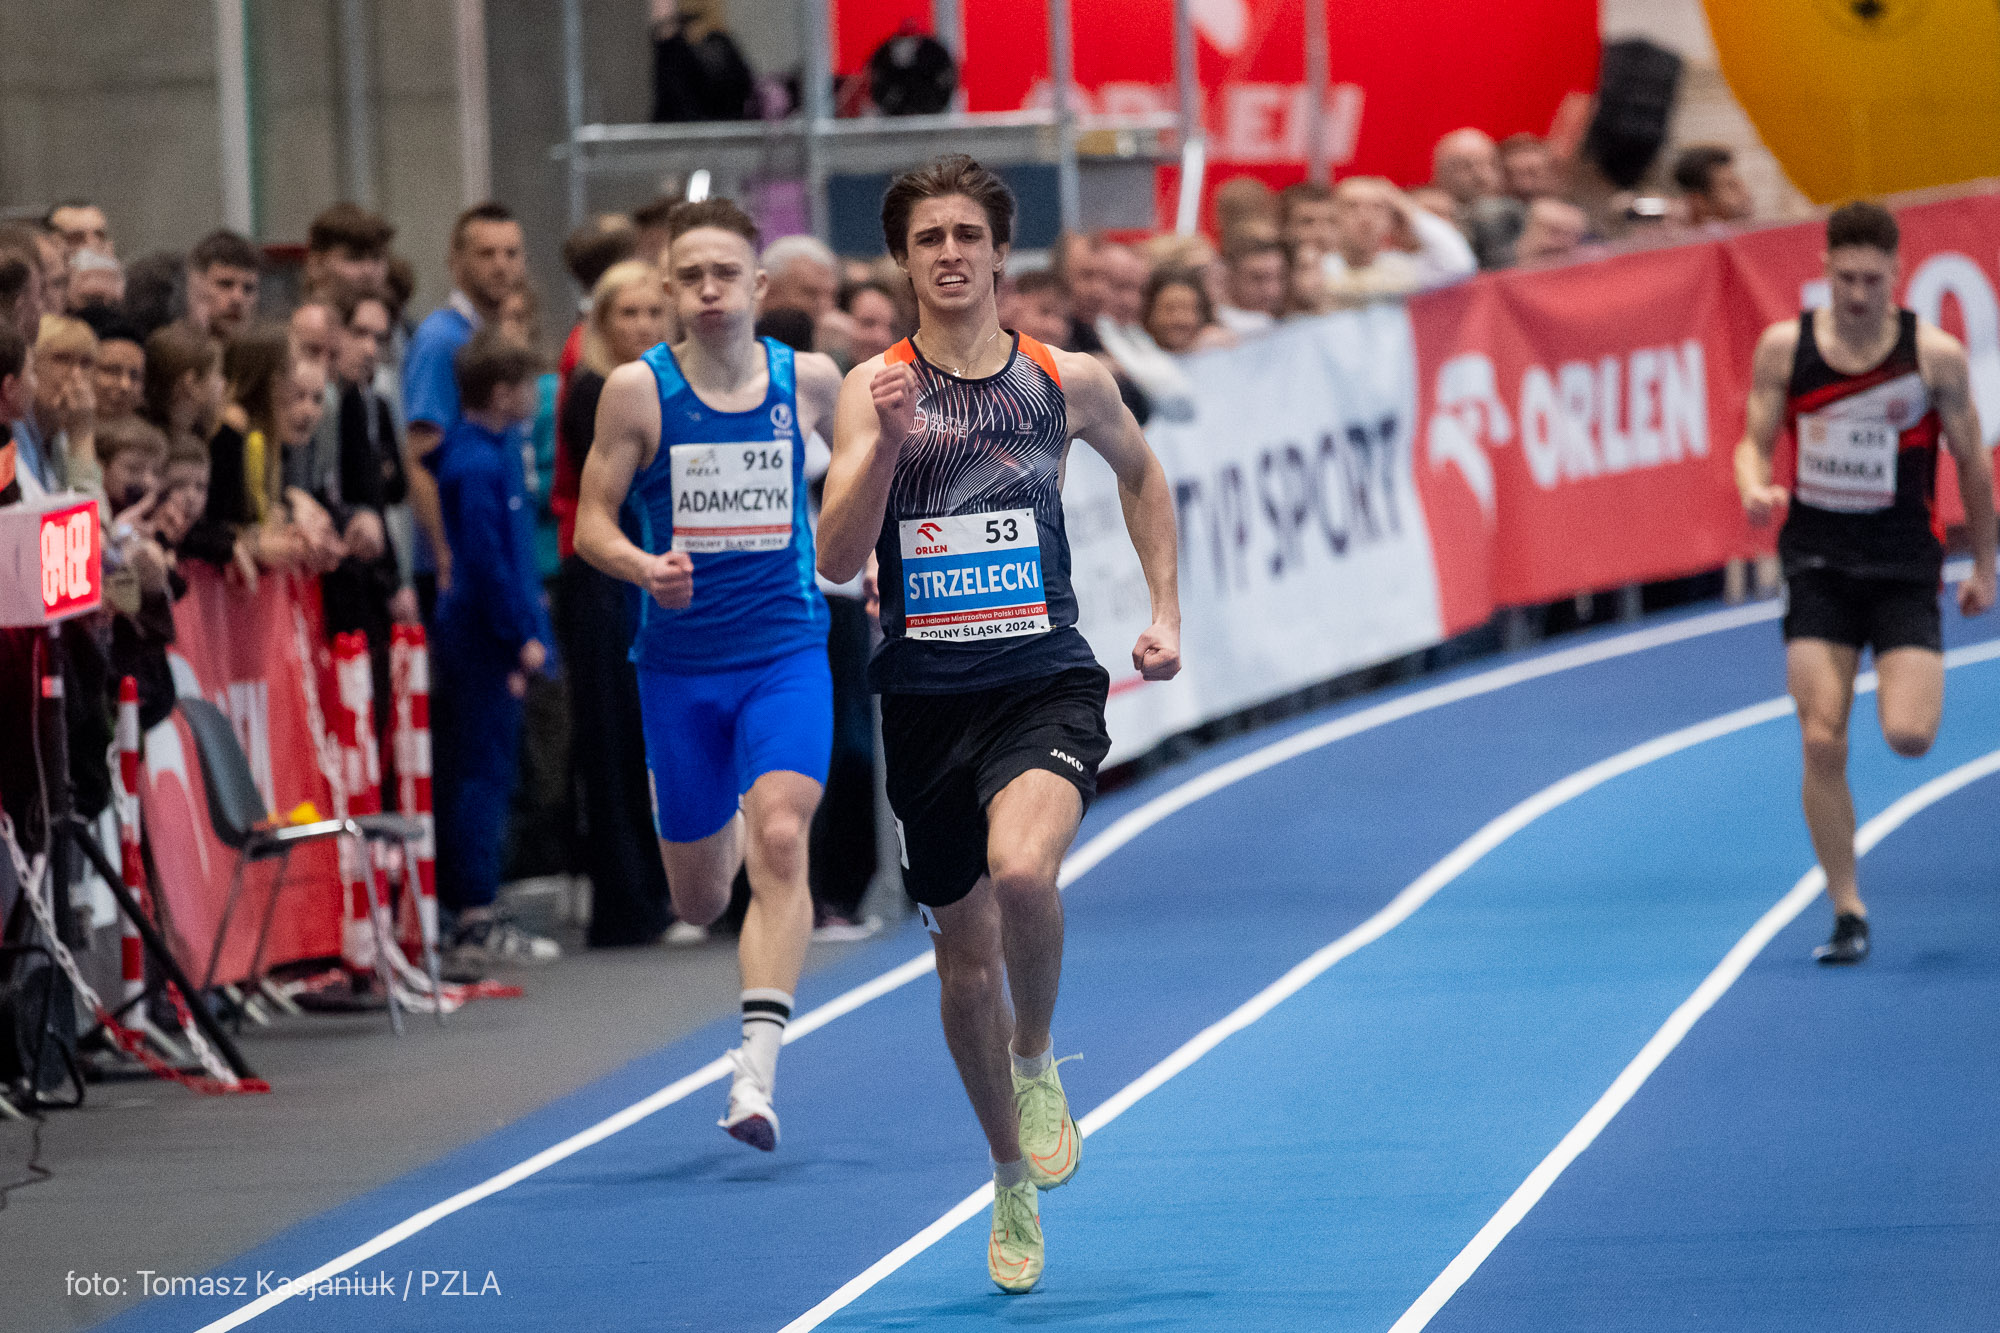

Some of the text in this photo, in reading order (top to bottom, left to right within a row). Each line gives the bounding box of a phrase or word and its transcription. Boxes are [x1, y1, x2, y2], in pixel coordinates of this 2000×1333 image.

[1522, 340, 1707, 490] ORLEN
[743, 450, 783, 470] 916
[678, 488, 788, 512] ADAMCZYK
[1258, 412, 1403, 577] SPORT
[985, 518, 1019, 544] 53
[915, 545, 948, 555] ORLEN
[908, 561, 1039, 600] STRZELECKI
[910, 618, 925, 626] PZLA
[927, 615, 950, 624] Halowe
[951, 613, 993, 622] Mistrzostwa
[993, 609, 1014, 618] Polski
[1015, 608, 1026, 616] U18
[1031, 606, 1044, 614] U20
[920, 620, 1035, 639] DOLNY ŚLĄSK 2024
[1050, 748, 1083, 772] JAKO
